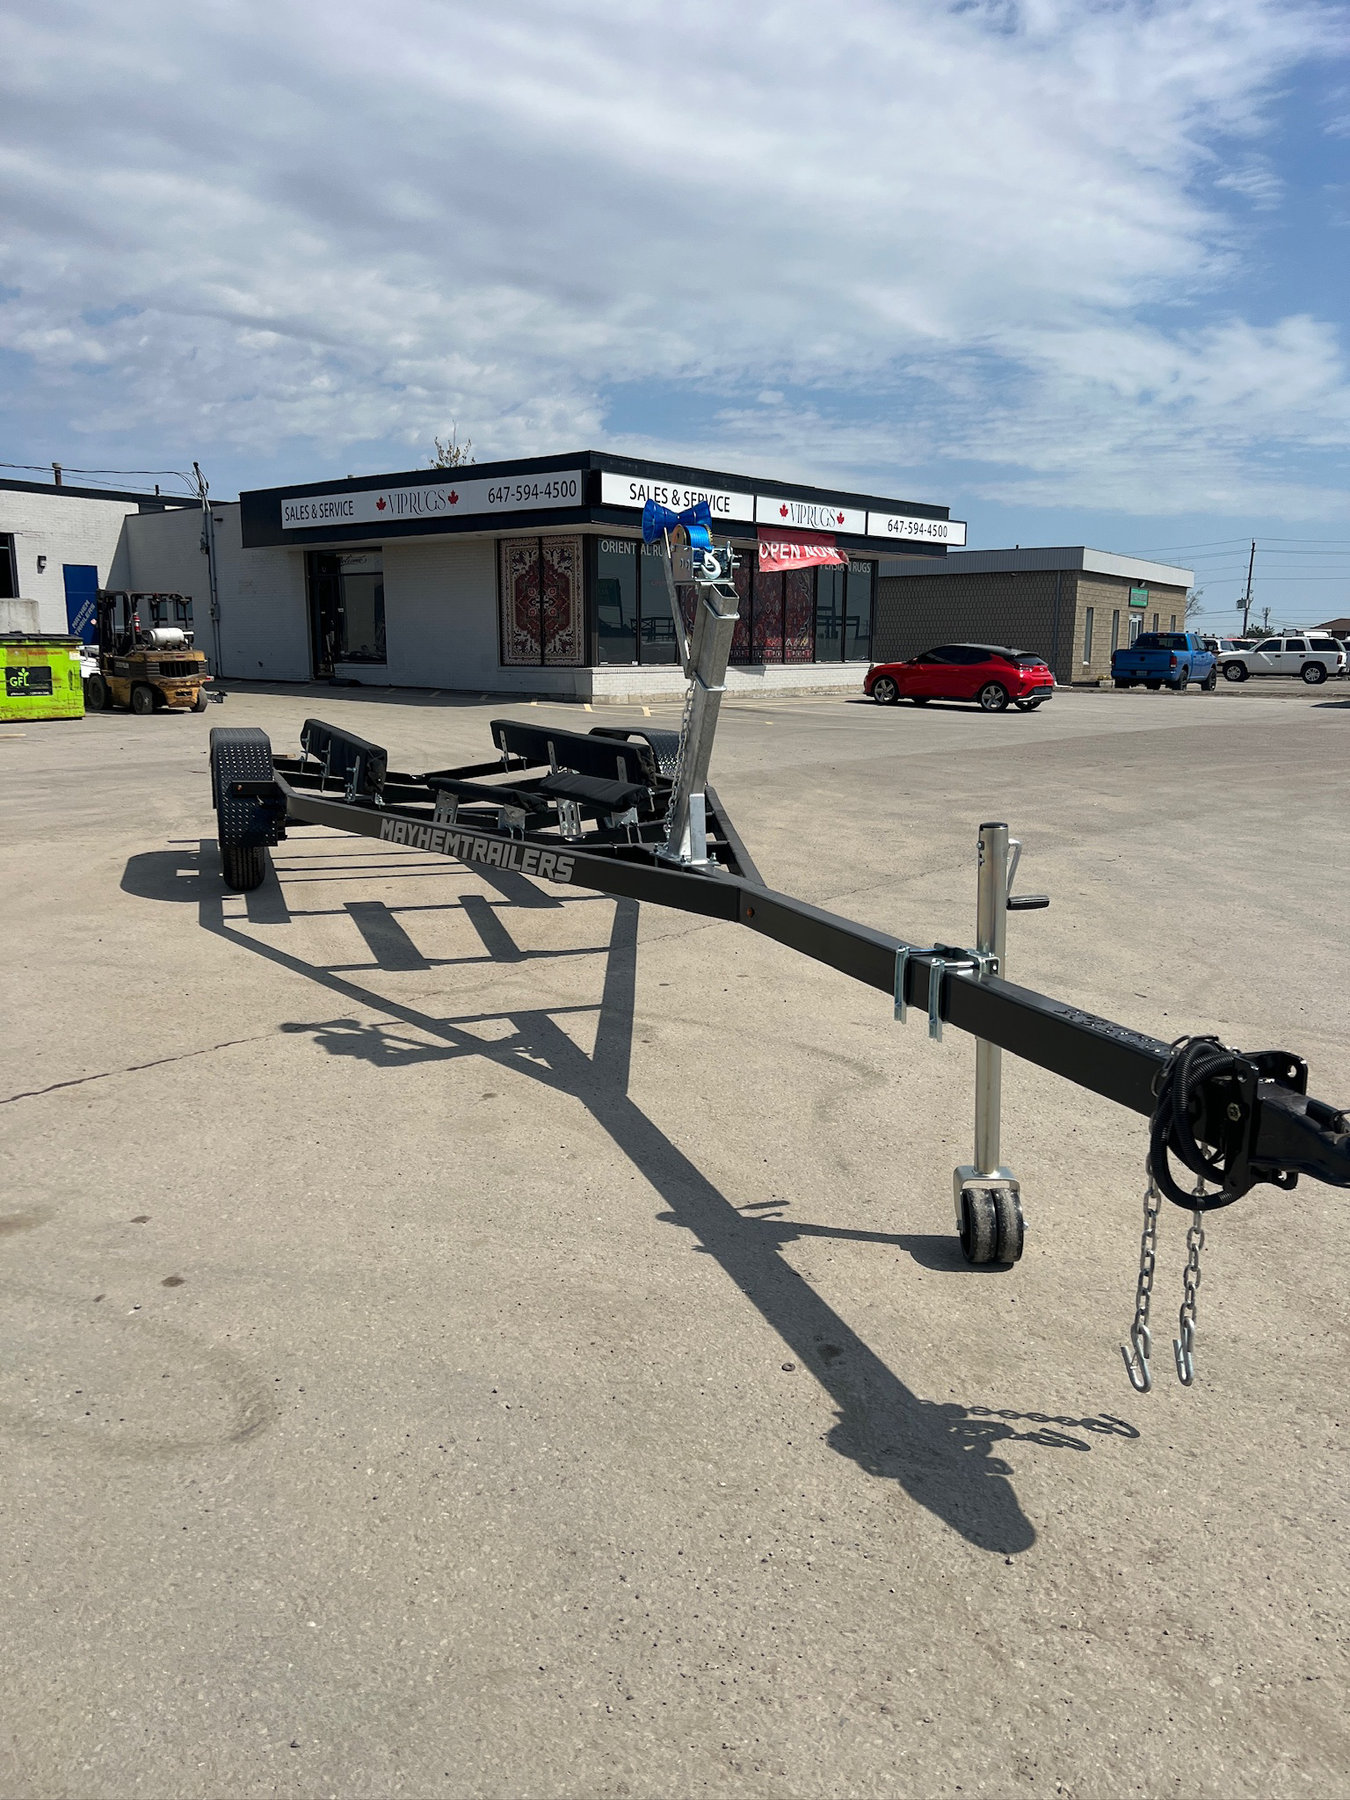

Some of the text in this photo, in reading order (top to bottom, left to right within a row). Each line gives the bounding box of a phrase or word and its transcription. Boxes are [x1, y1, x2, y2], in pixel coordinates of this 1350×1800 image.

[487, 480, 577, 504] 647-594-4500
[629, 483, 668, 505] SALES
[671, 489, 680, 506] &
[285, 500, 354, 522] SALES & SERVICE
[887, 518, 948, 538] 647-594-4500
[759, 542, 840, 559] OPEN NOW
[852, 561, 872, 573] RUGS
[9, 673, 30, 687] GFL
